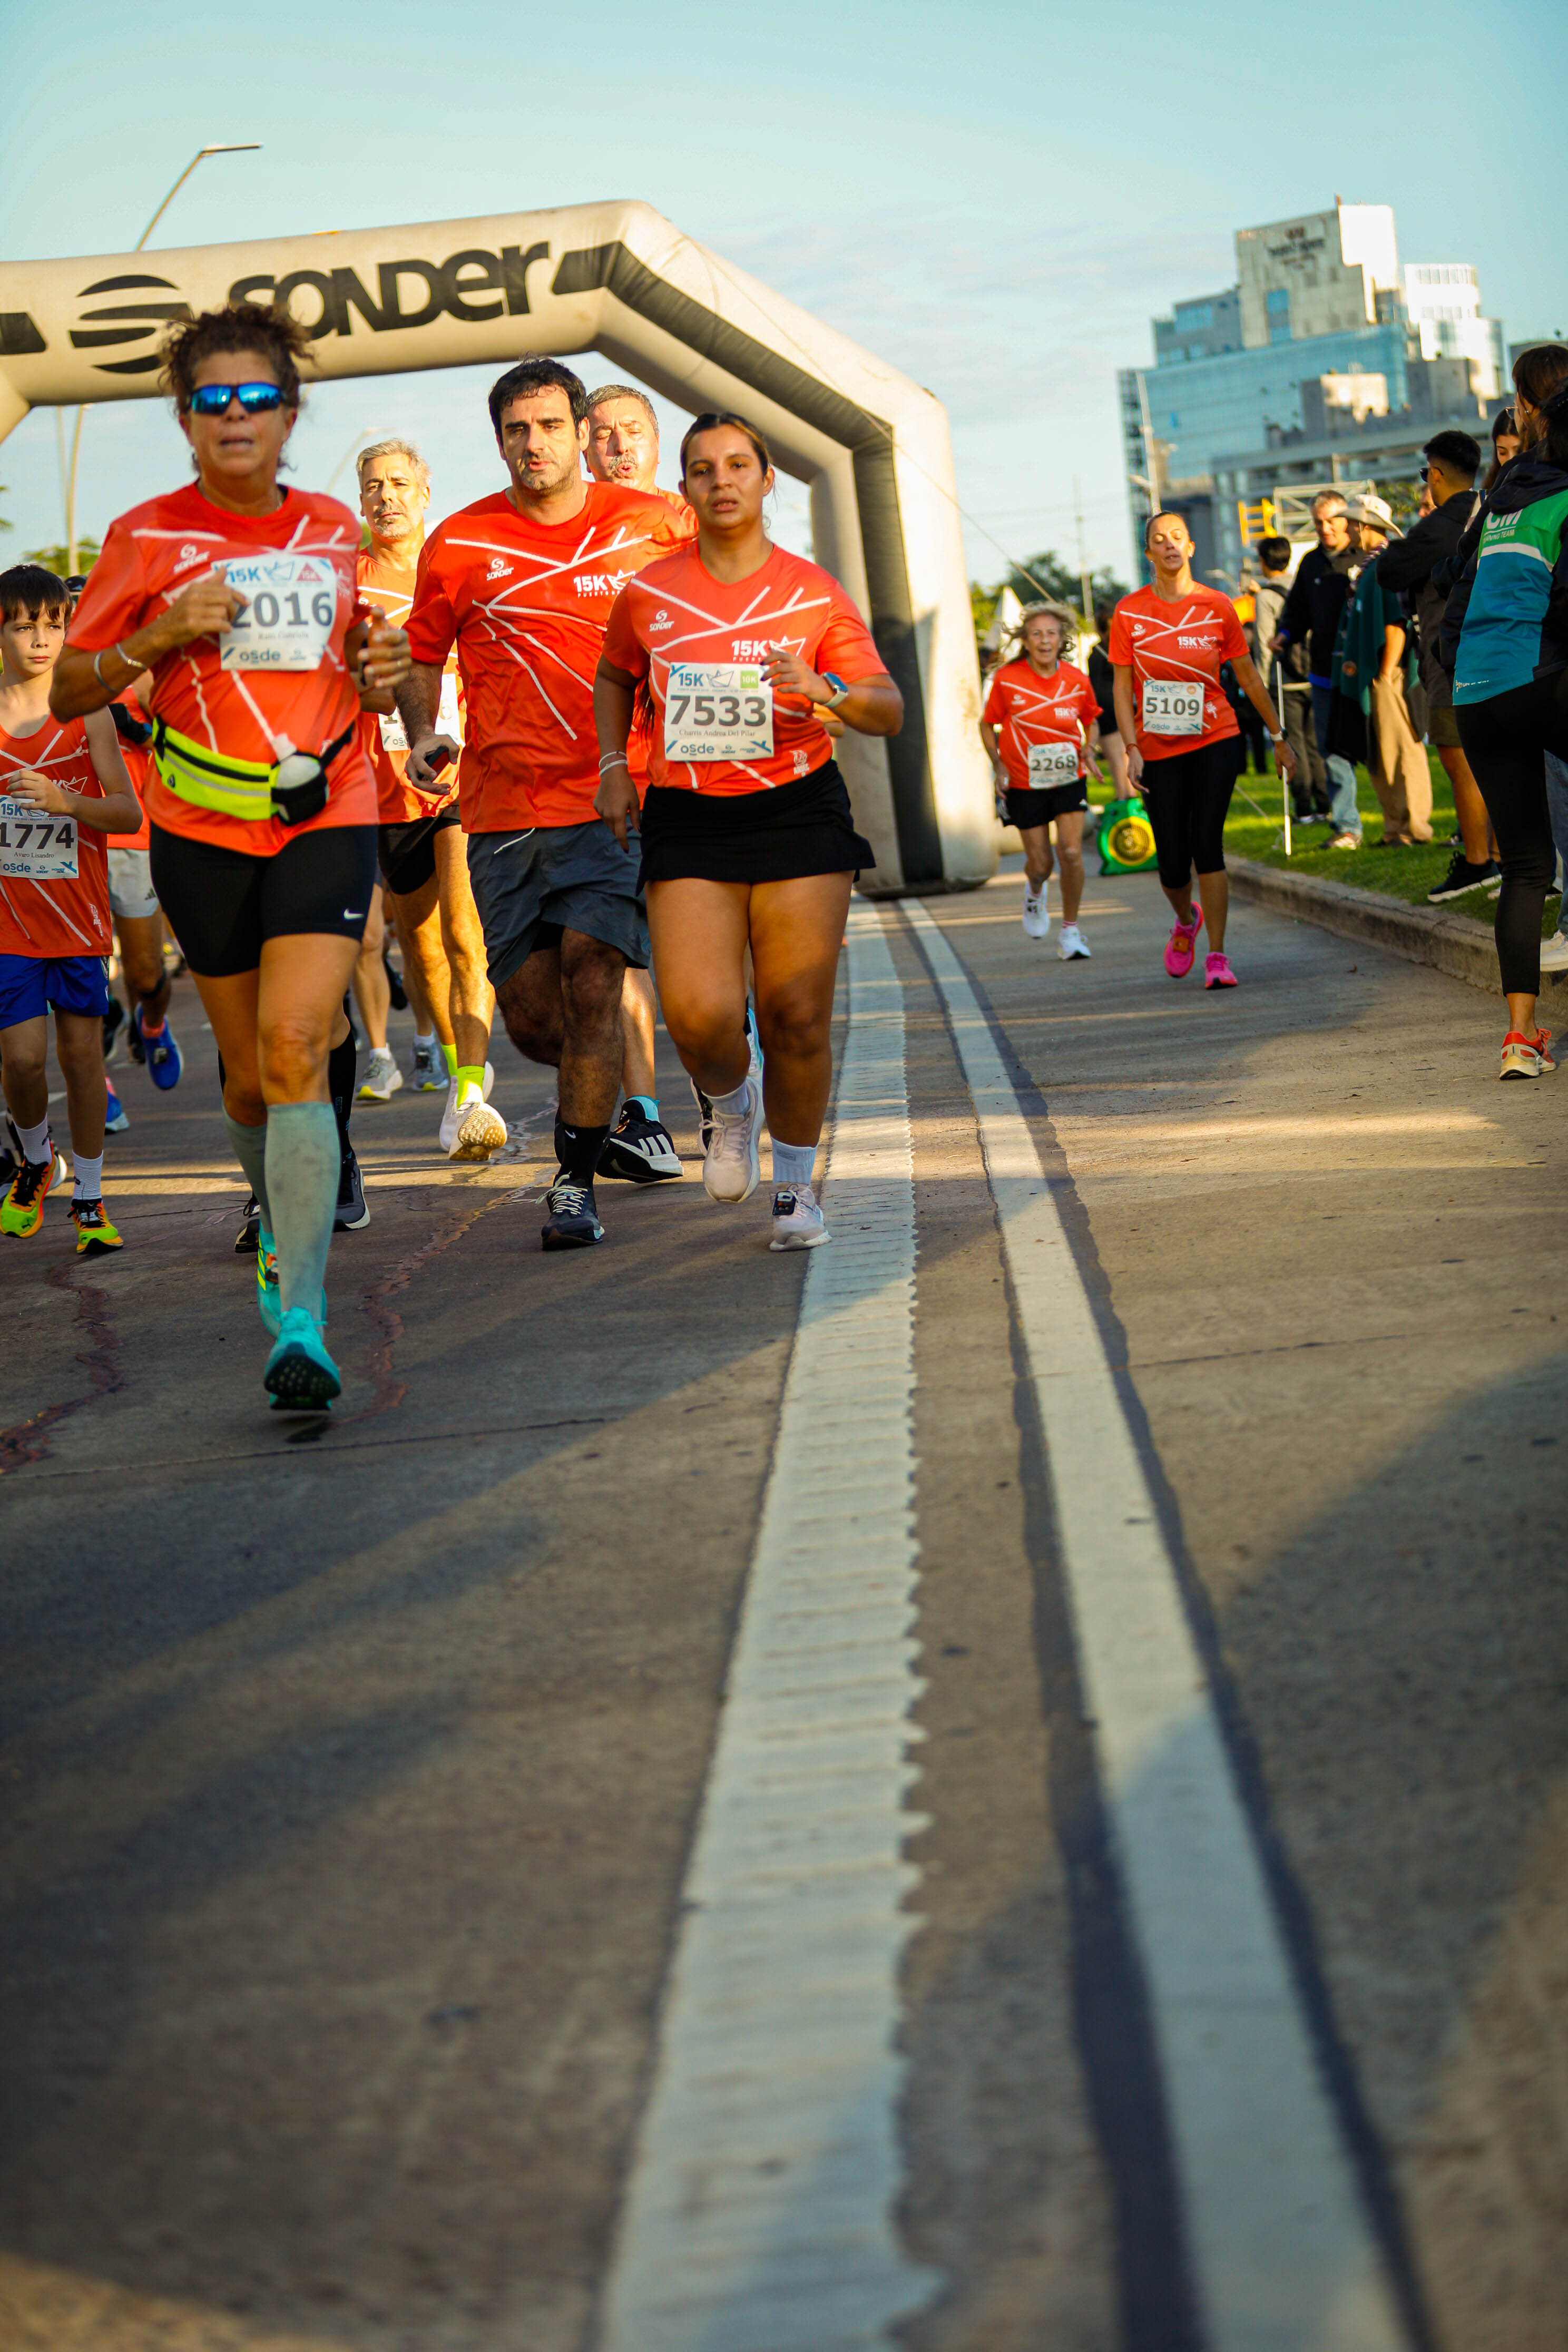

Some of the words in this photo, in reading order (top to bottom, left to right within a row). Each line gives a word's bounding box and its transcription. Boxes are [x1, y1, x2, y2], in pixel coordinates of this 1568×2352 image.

[1501, 529, 1515, 538] TEAM
[227, 566, 261, 582] 15K
[573, 574, 607, 592] 15K
[230, 591, 333, 628] 2016
[731, 640, 768, 656] 15K
[1177, 636, 1197, 645] 15K
[678, 672, 704, 687] 15K
[670, 694, 766, 727] 7533
[1145, 696, 1200, 716] 5109
[681, 742, 714, 754] osde
[1031, 754, 1076, 771] 2268
[1, 803, 23, 816] 15K
[0, 822, 74, 849] 1774
[3, 863, 31, 873] osde
